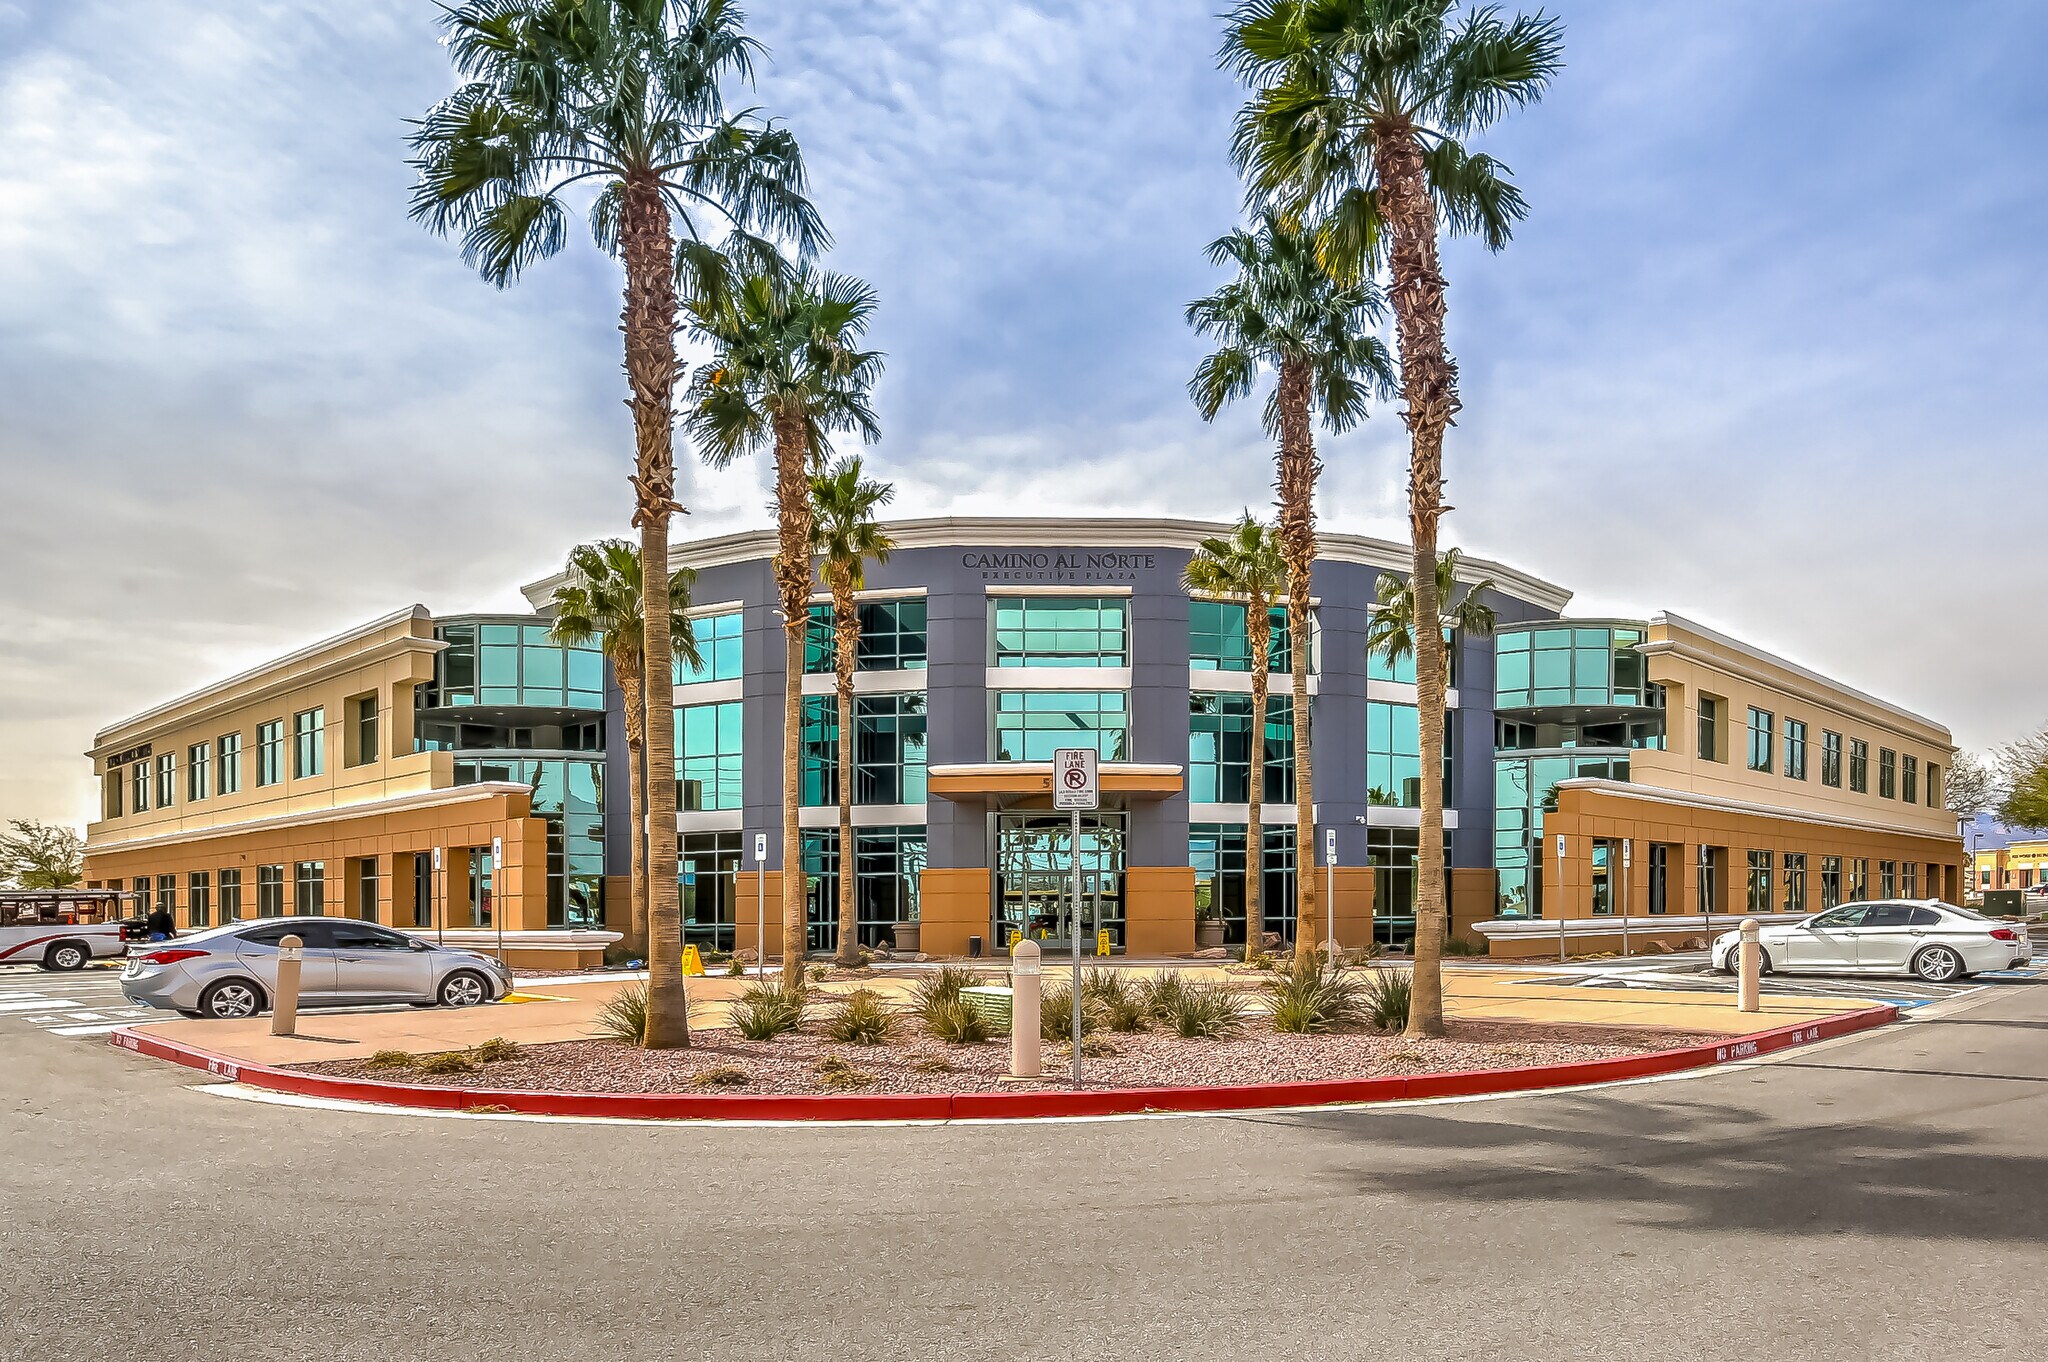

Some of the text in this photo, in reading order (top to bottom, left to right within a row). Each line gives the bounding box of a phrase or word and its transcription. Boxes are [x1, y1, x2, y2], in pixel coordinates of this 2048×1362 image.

[962, 552, 1155, 569] CAMINO AL NORTE
[982, 571, 1136, 580] EXECUTIVE PLAZA
[1066, 751, 1084, 760] FIRE
[1065, 760, 1085, 768] LANE
[1731, 1041, 1757, 1058] PARKING
